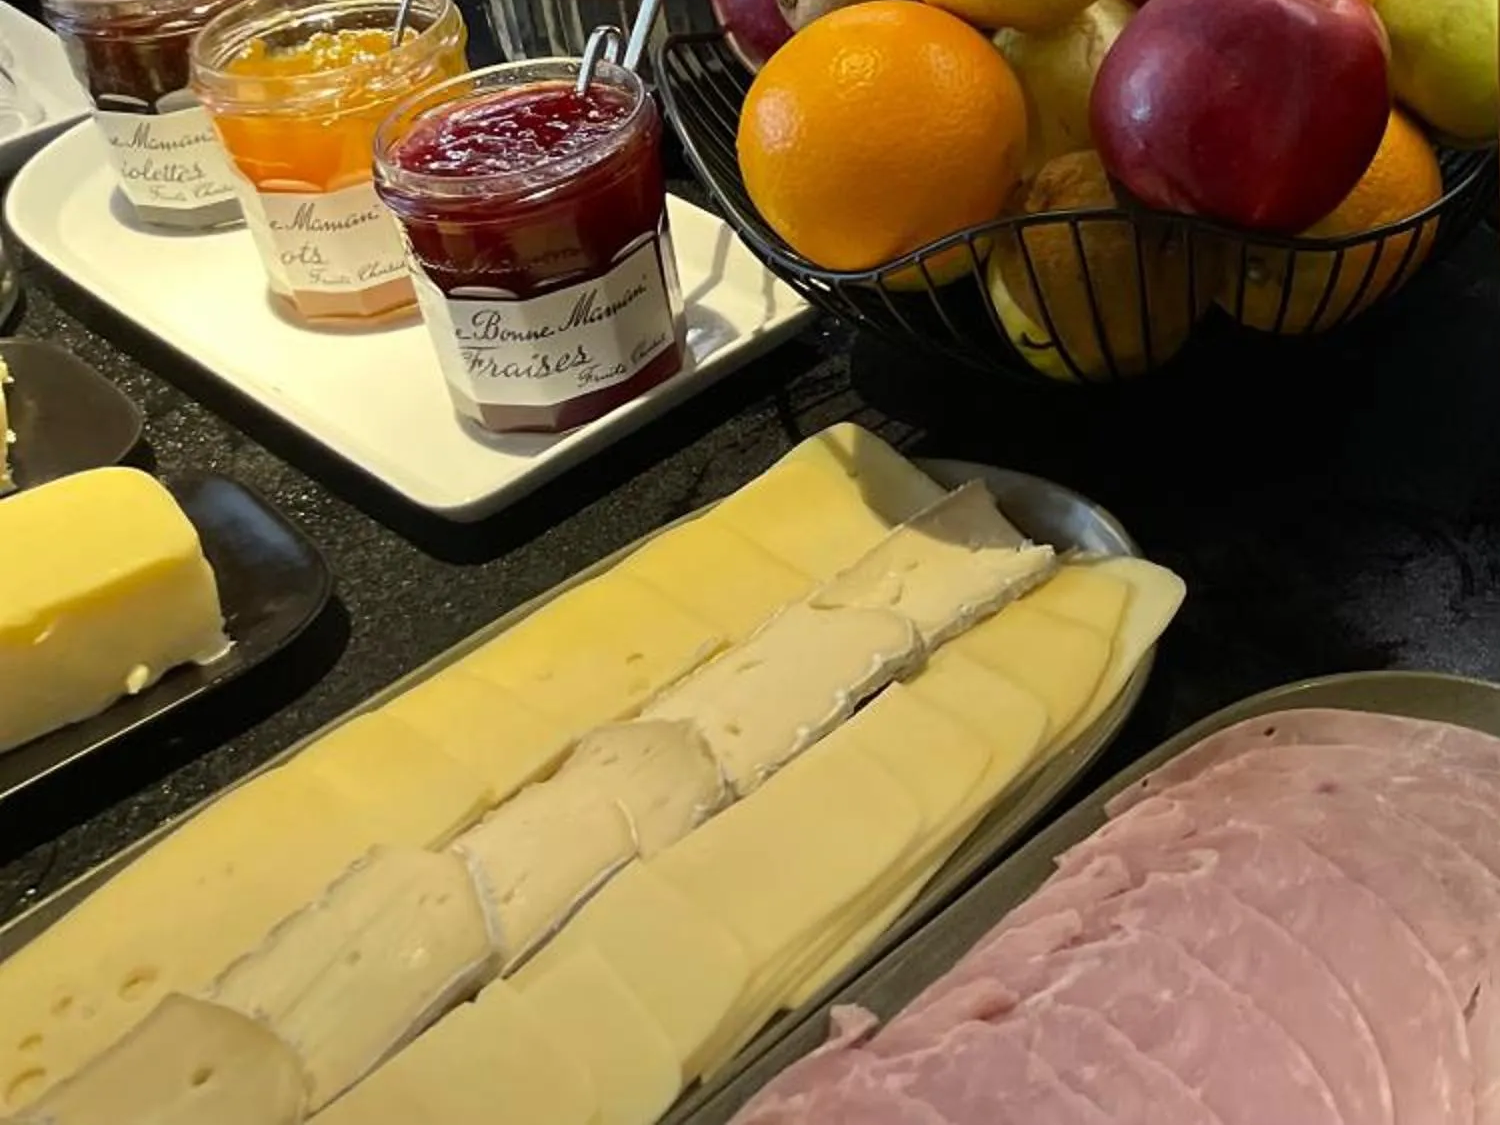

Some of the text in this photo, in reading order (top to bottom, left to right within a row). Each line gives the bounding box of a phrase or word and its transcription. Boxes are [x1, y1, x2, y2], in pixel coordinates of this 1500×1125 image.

[121, 158, 205, 183] iolettes
[469, 278, 648, 341] Bonne Maman
[459, 344, 594, 378] Fraises
